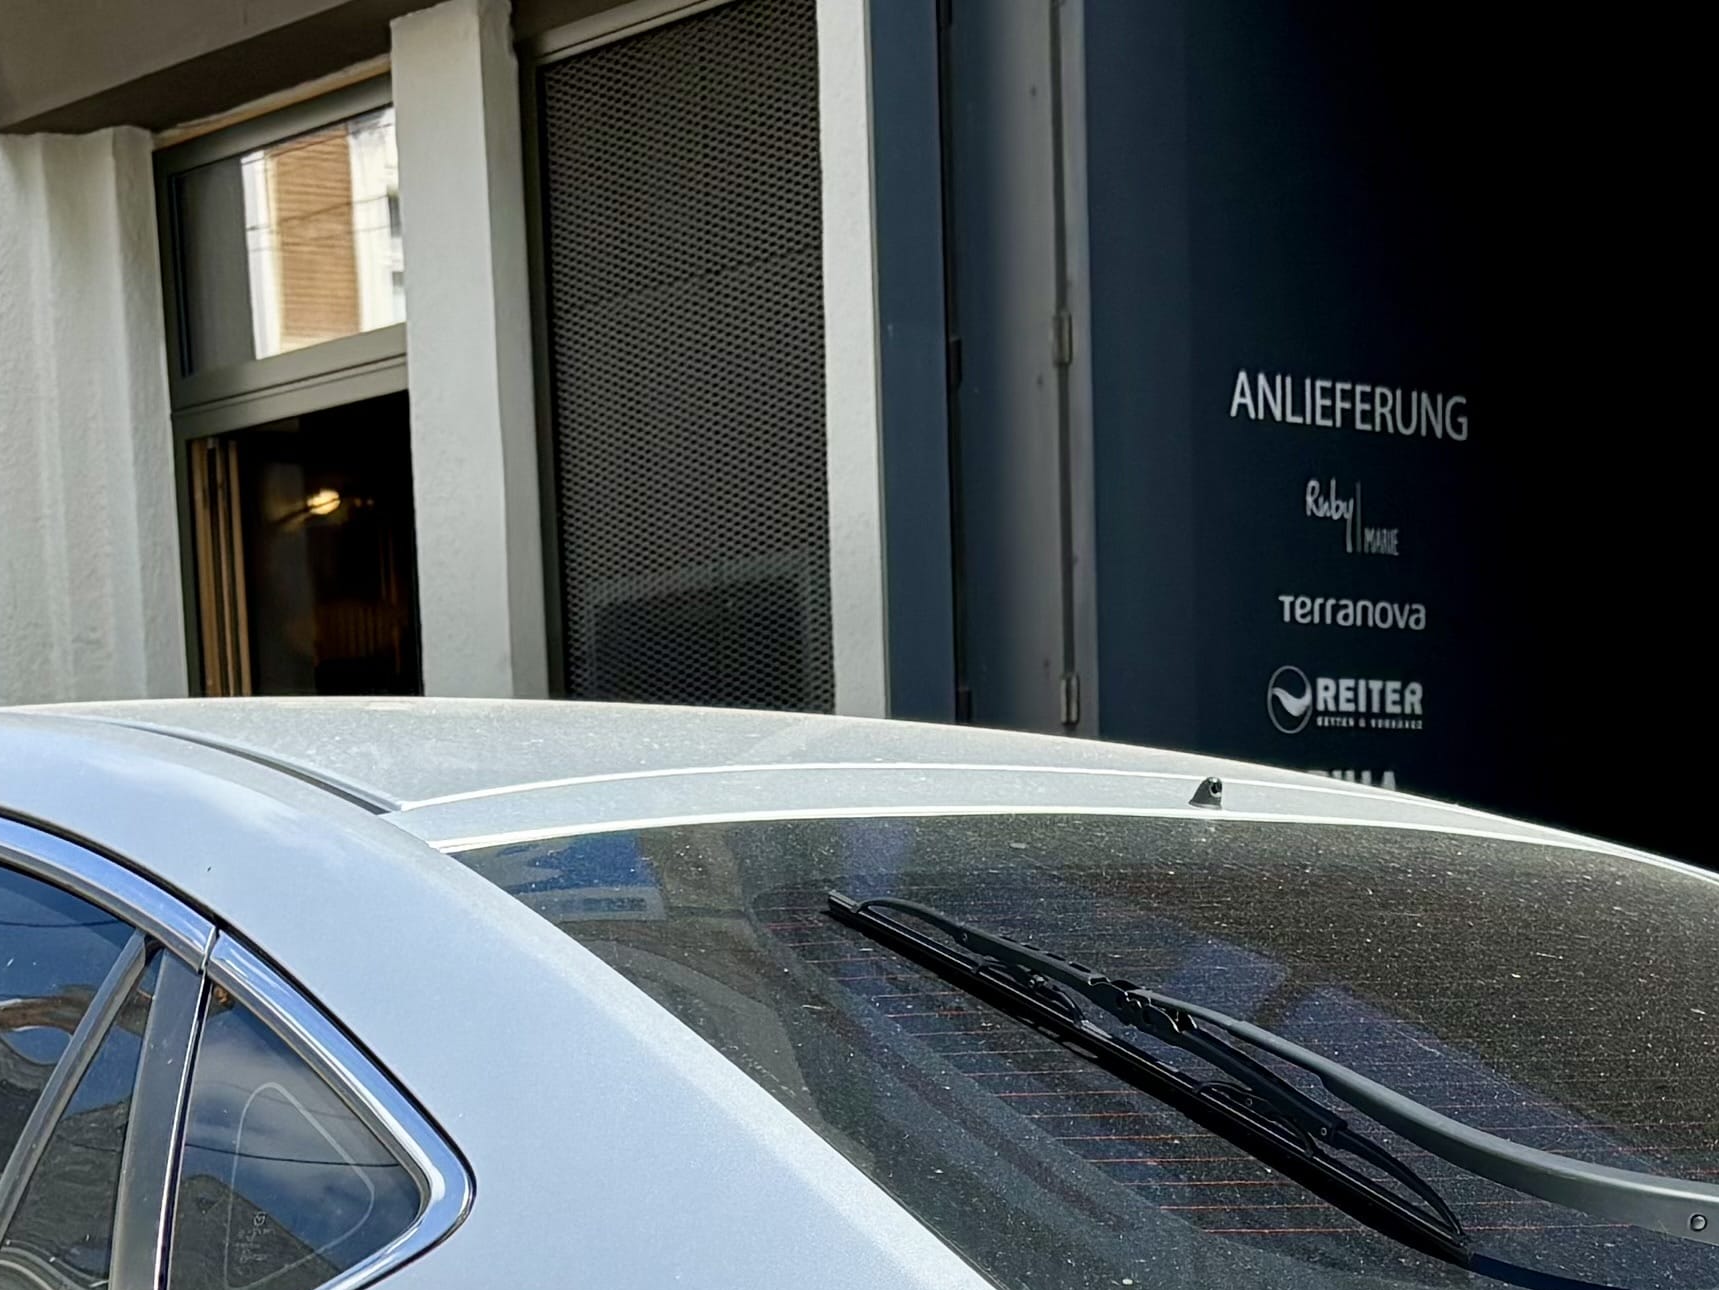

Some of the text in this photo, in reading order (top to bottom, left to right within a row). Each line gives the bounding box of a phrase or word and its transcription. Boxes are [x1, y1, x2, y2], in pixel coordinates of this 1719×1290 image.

[1230, 369, 1468, 441] ANLIEFERUNG
[1305, 477, 1354, 554] Ruby
[1316, 677, 1423, 715] REITER
